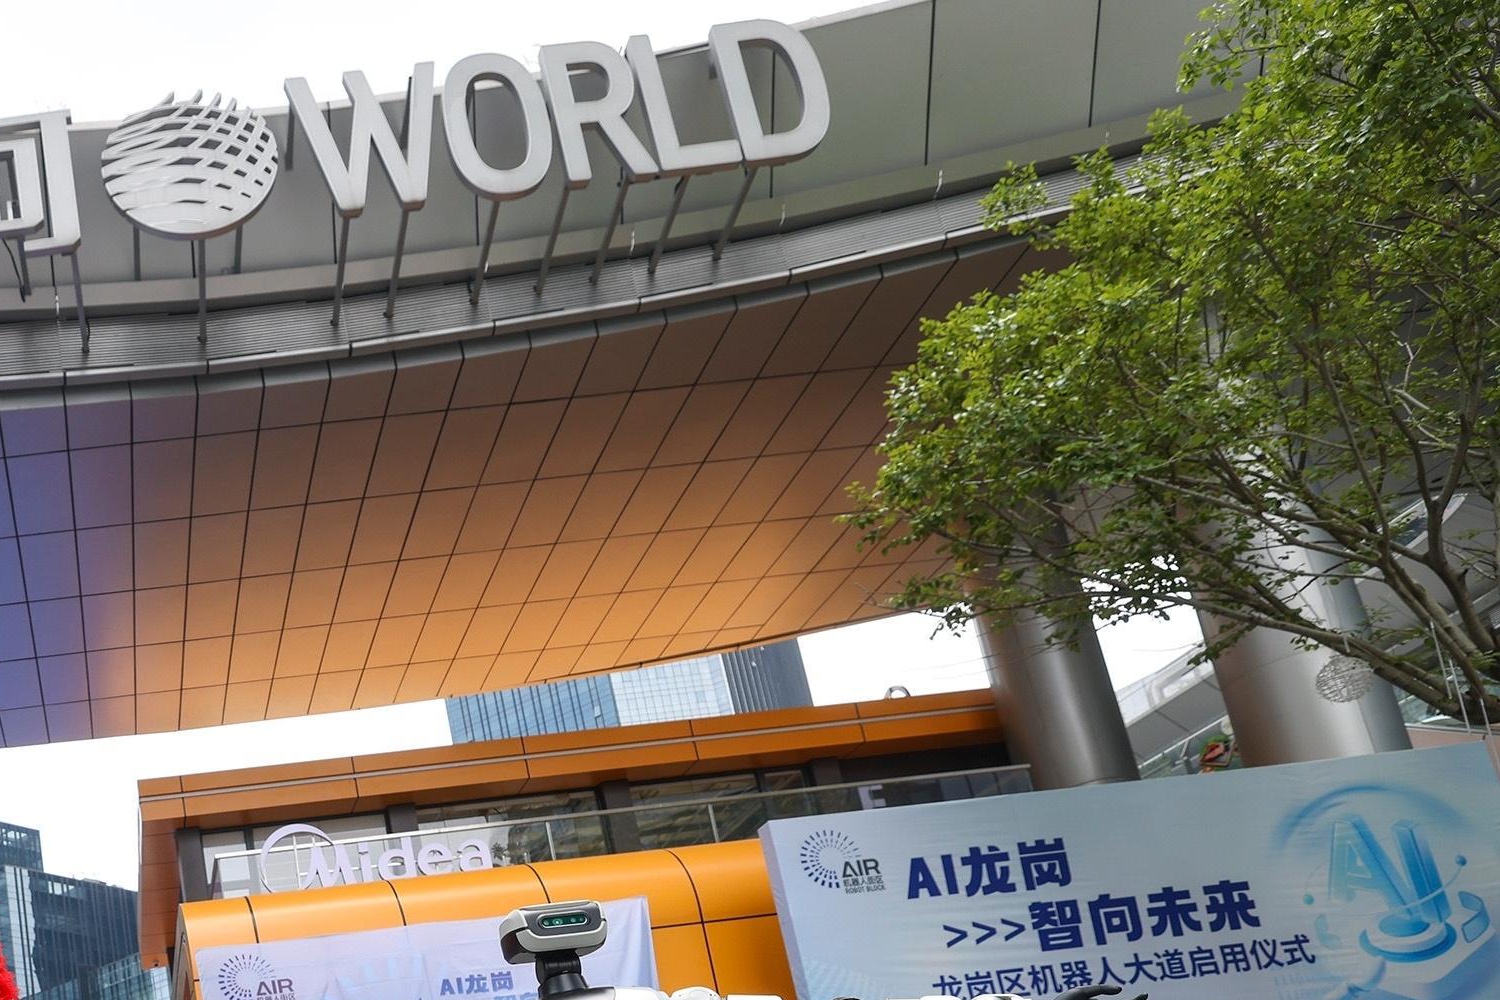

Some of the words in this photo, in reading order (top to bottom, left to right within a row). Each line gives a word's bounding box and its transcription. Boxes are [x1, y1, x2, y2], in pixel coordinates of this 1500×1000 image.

[284, 19, 831, 218] WORLD
[296, 830, 494, 891] Midea
[842, 858, 882, 878] AIR
[843, 875, 884, 887] 机器人街区
[907, 837, 1073, 900] AI龙岗
[1028, 880, 1262, 953] 智向未来
[256, 977, 294, 997] AIR
[440, 971, 514, 996] AI龙岗
[932, 933, 1317, 1000] 龙岗区机器人大道启用仪式
